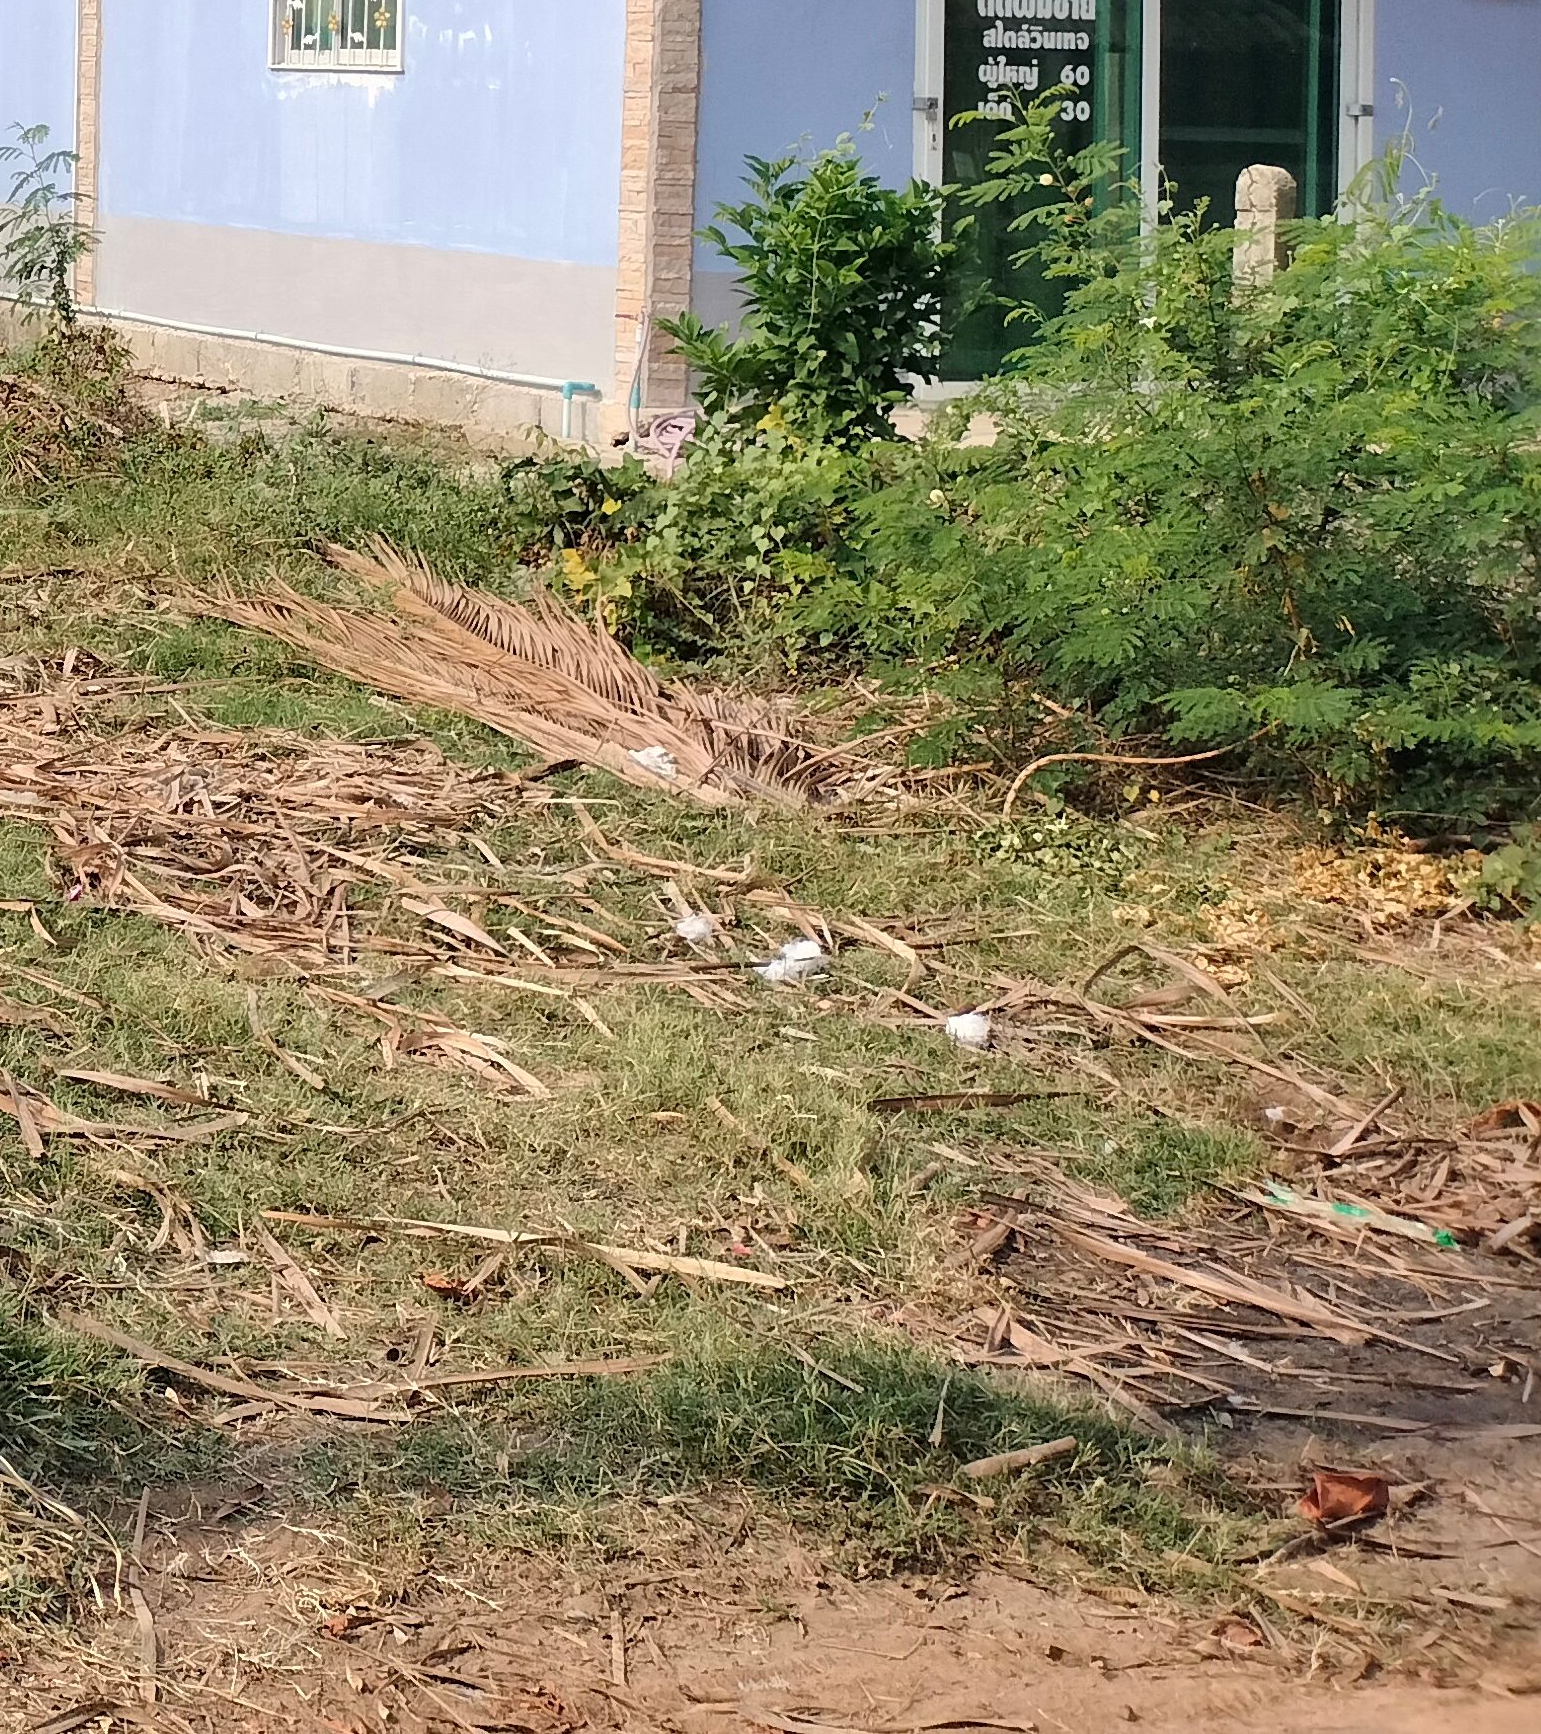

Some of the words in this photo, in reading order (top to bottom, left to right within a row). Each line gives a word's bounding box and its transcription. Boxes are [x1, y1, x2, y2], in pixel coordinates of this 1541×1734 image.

[982, 19, 1090, 50] สไตล์วินเทจ
[978, 55, 1039, 90] ผู้ใหญ่
[1060, 64, 1090, 85] 60
[1060, 100, 1090, 121] 30
